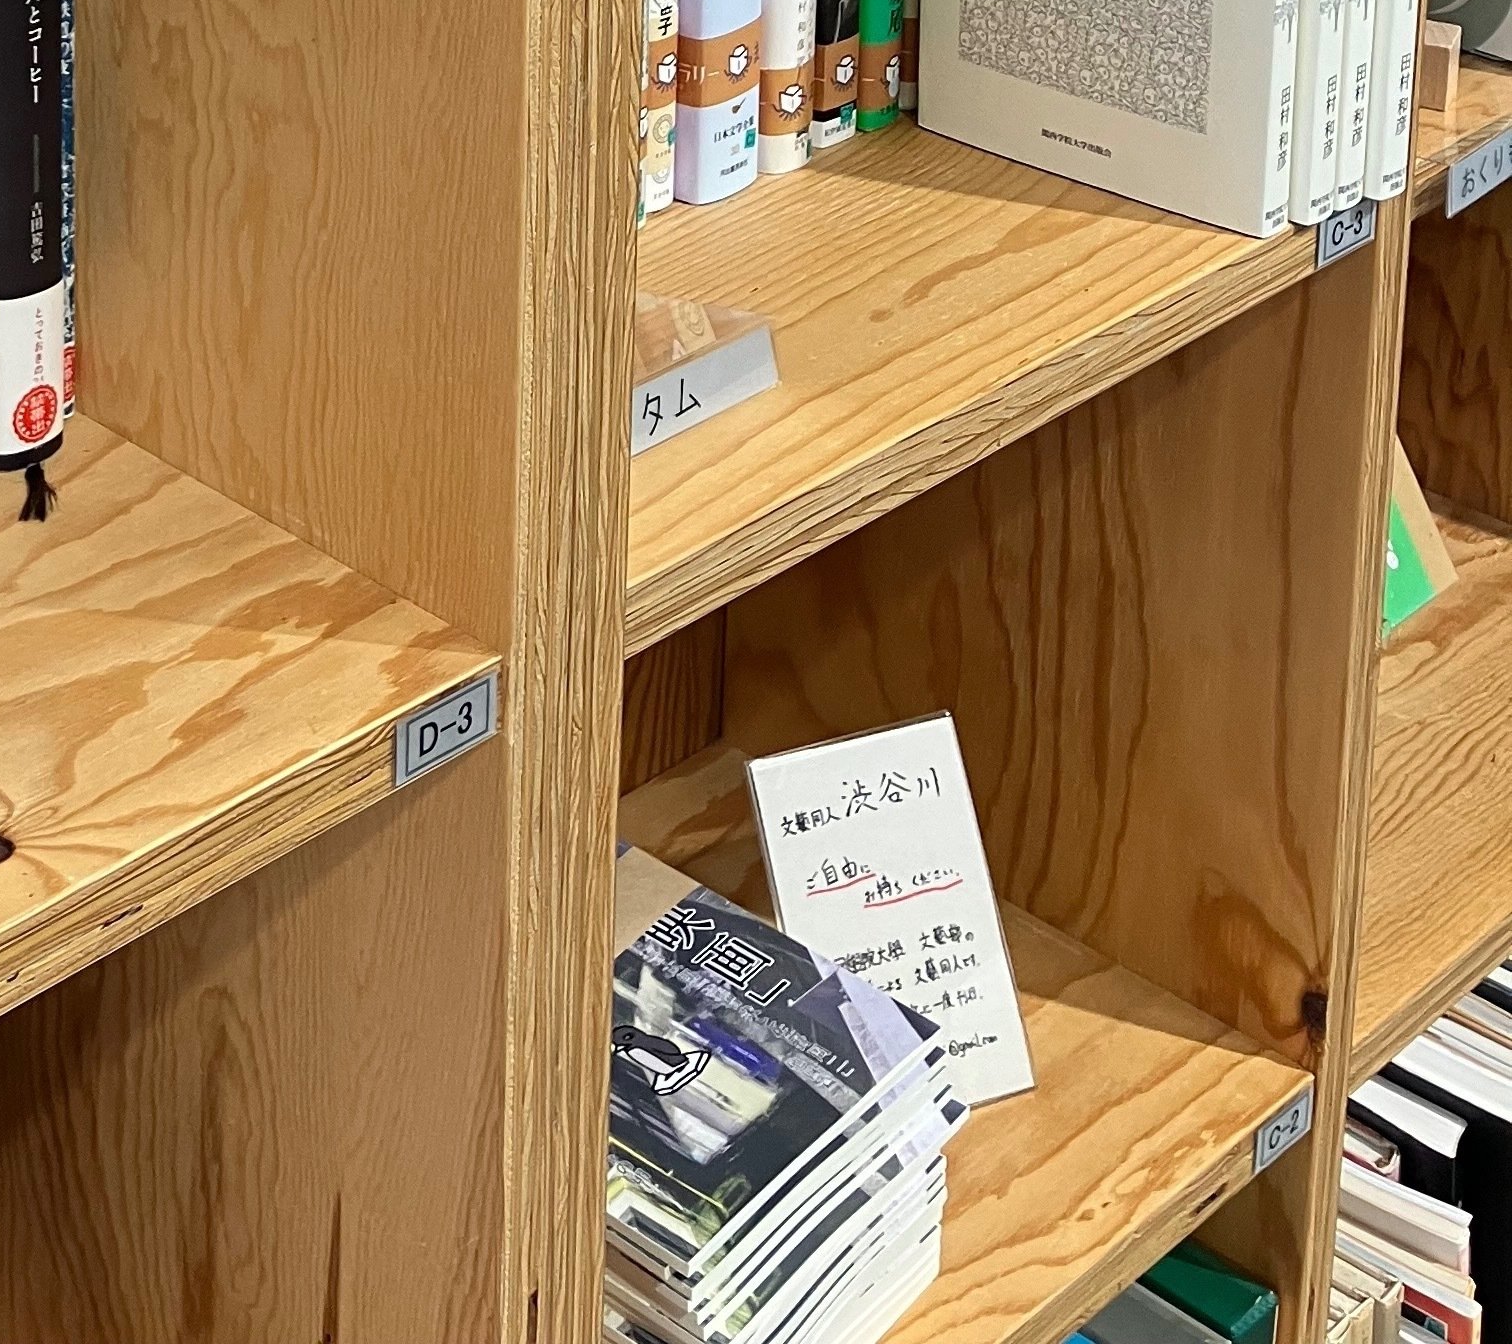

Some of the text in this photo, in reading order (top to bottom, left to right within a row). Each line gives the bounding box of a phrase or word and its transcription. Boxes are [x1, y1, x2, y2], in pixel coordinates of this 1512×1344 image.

[1461, 144, 1512, 198] おくり
[1331, 210, 1364, 247] C-3
[641, 377, 701, 437] タム
[419, 701, 473, 758] D-3
[840, 766, 942, 818] 渋谷川
[806, 857, 872, 891] ご自由に
[1267, 1108, 1301, 1150] C-2
